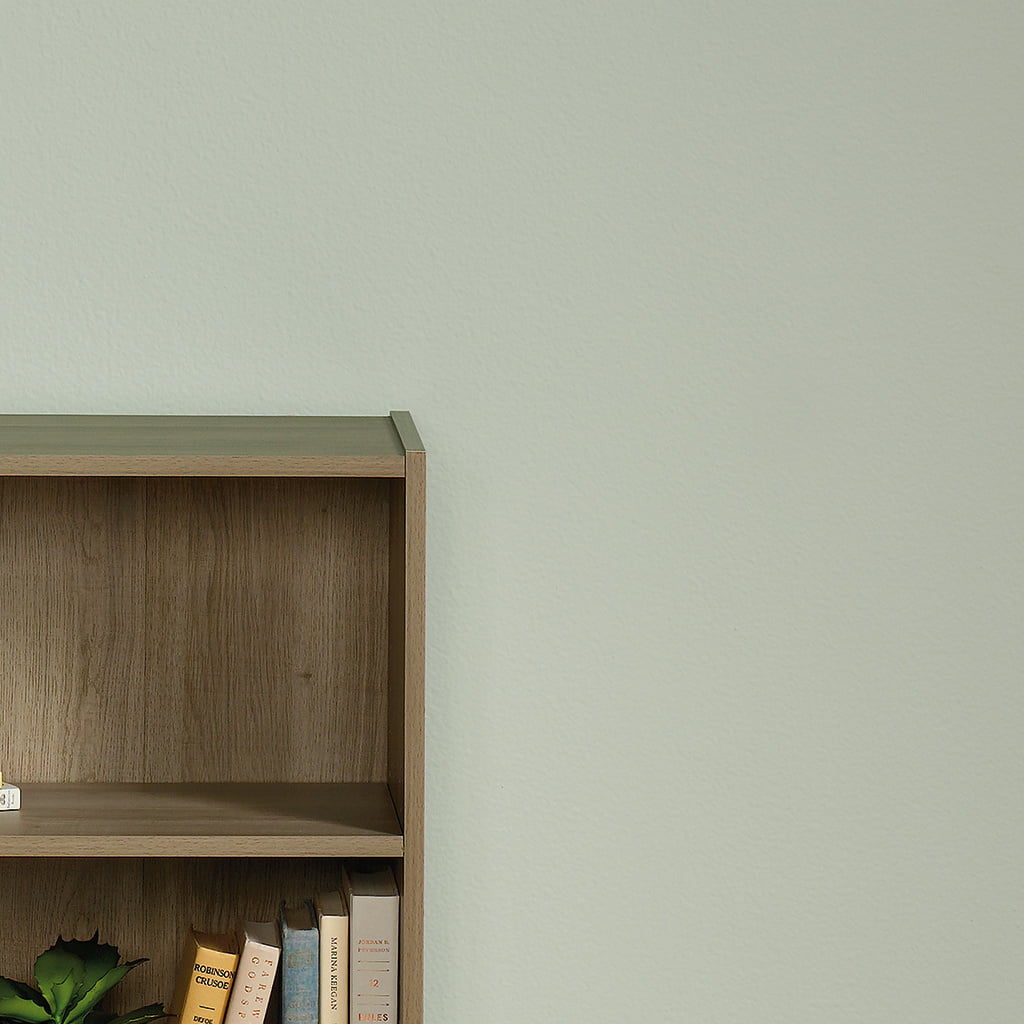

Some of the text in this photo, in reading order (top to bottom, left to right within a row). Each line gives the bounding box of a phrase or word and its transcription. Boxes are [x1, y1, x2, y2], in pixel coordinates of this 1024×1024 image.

[194, 963, 236, 979] ROBINSON
[330, 936, 338, 1011] MARINA KEEGAN
[195, 975, 229, 990] CRUSOE
[368, 979, 379, 988] 12
